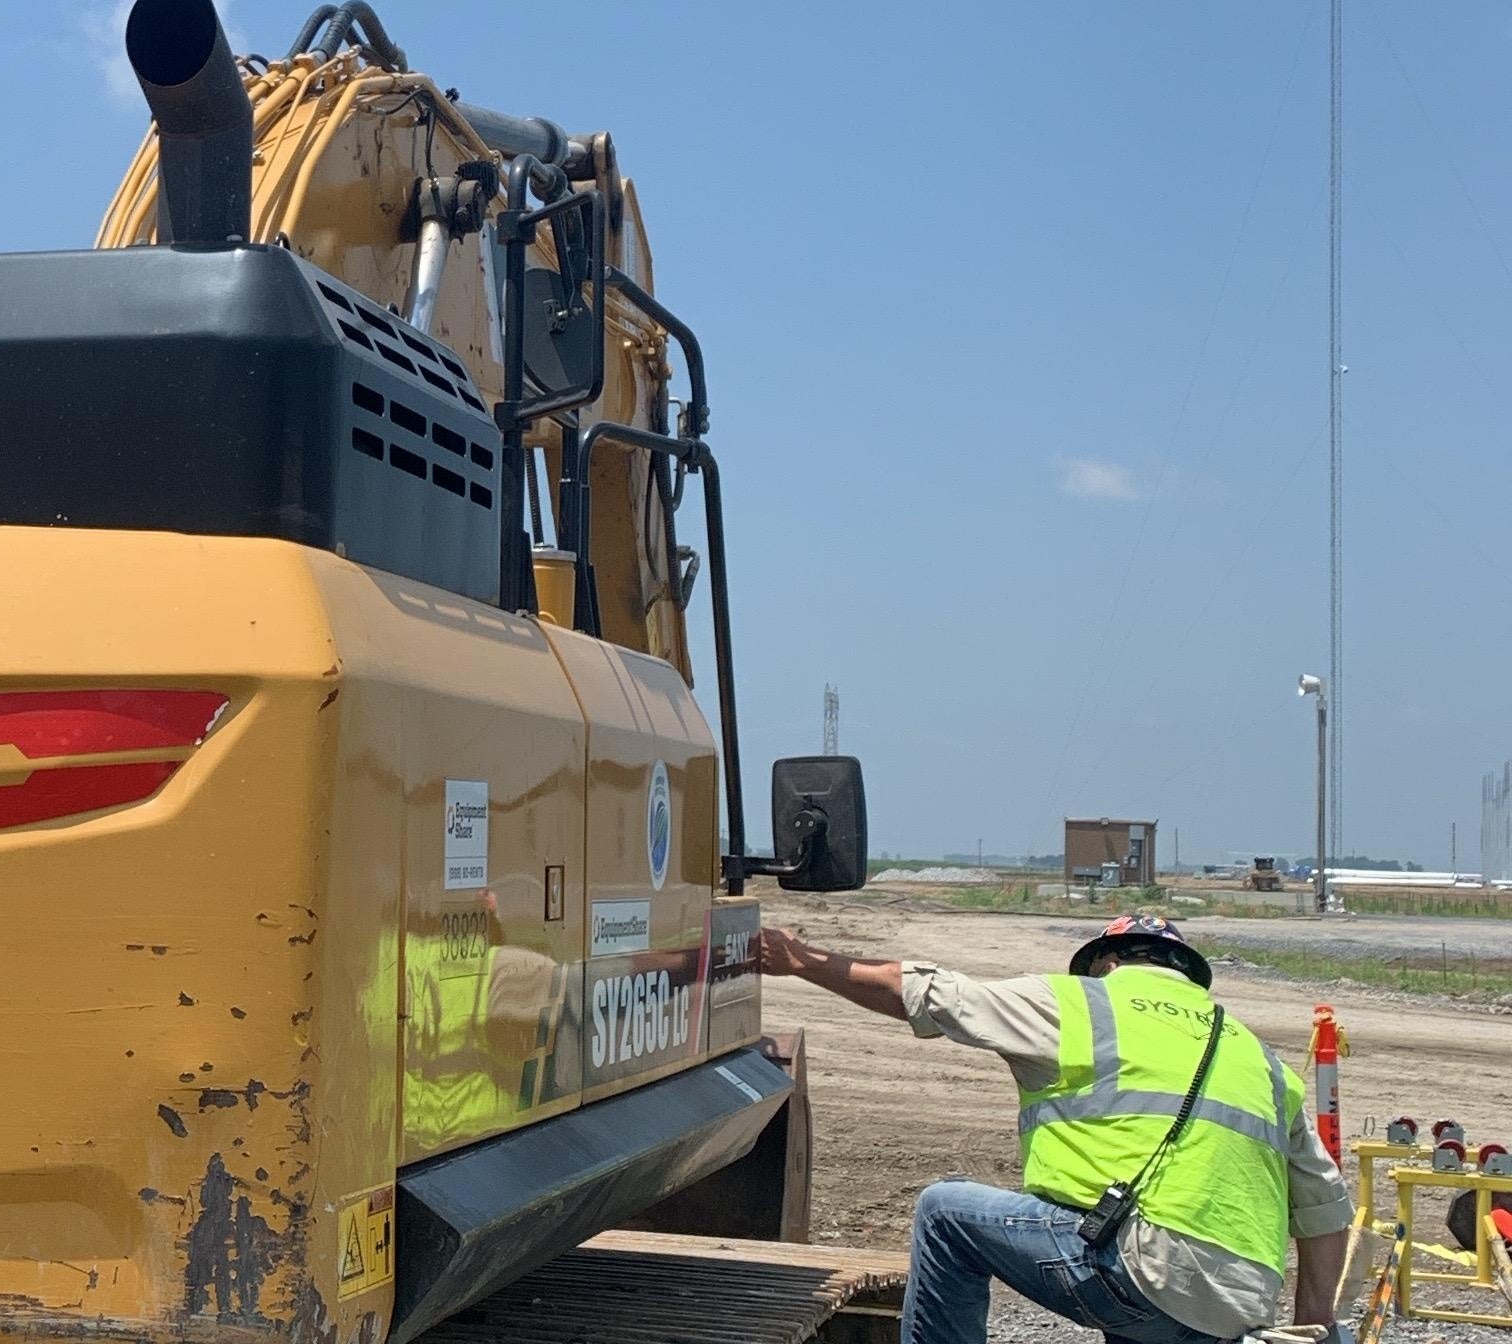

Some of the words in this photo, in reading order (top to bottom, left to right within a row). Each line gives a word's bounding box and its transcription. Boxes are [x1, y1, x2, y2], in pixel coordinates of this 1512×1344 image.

[441, 911, 487, 962] 38823
[591, 970, 670, 1068] SY265C
[673, 985, 689, 1047] LC
[1130, 998, 1239, 1038] SYSTS
